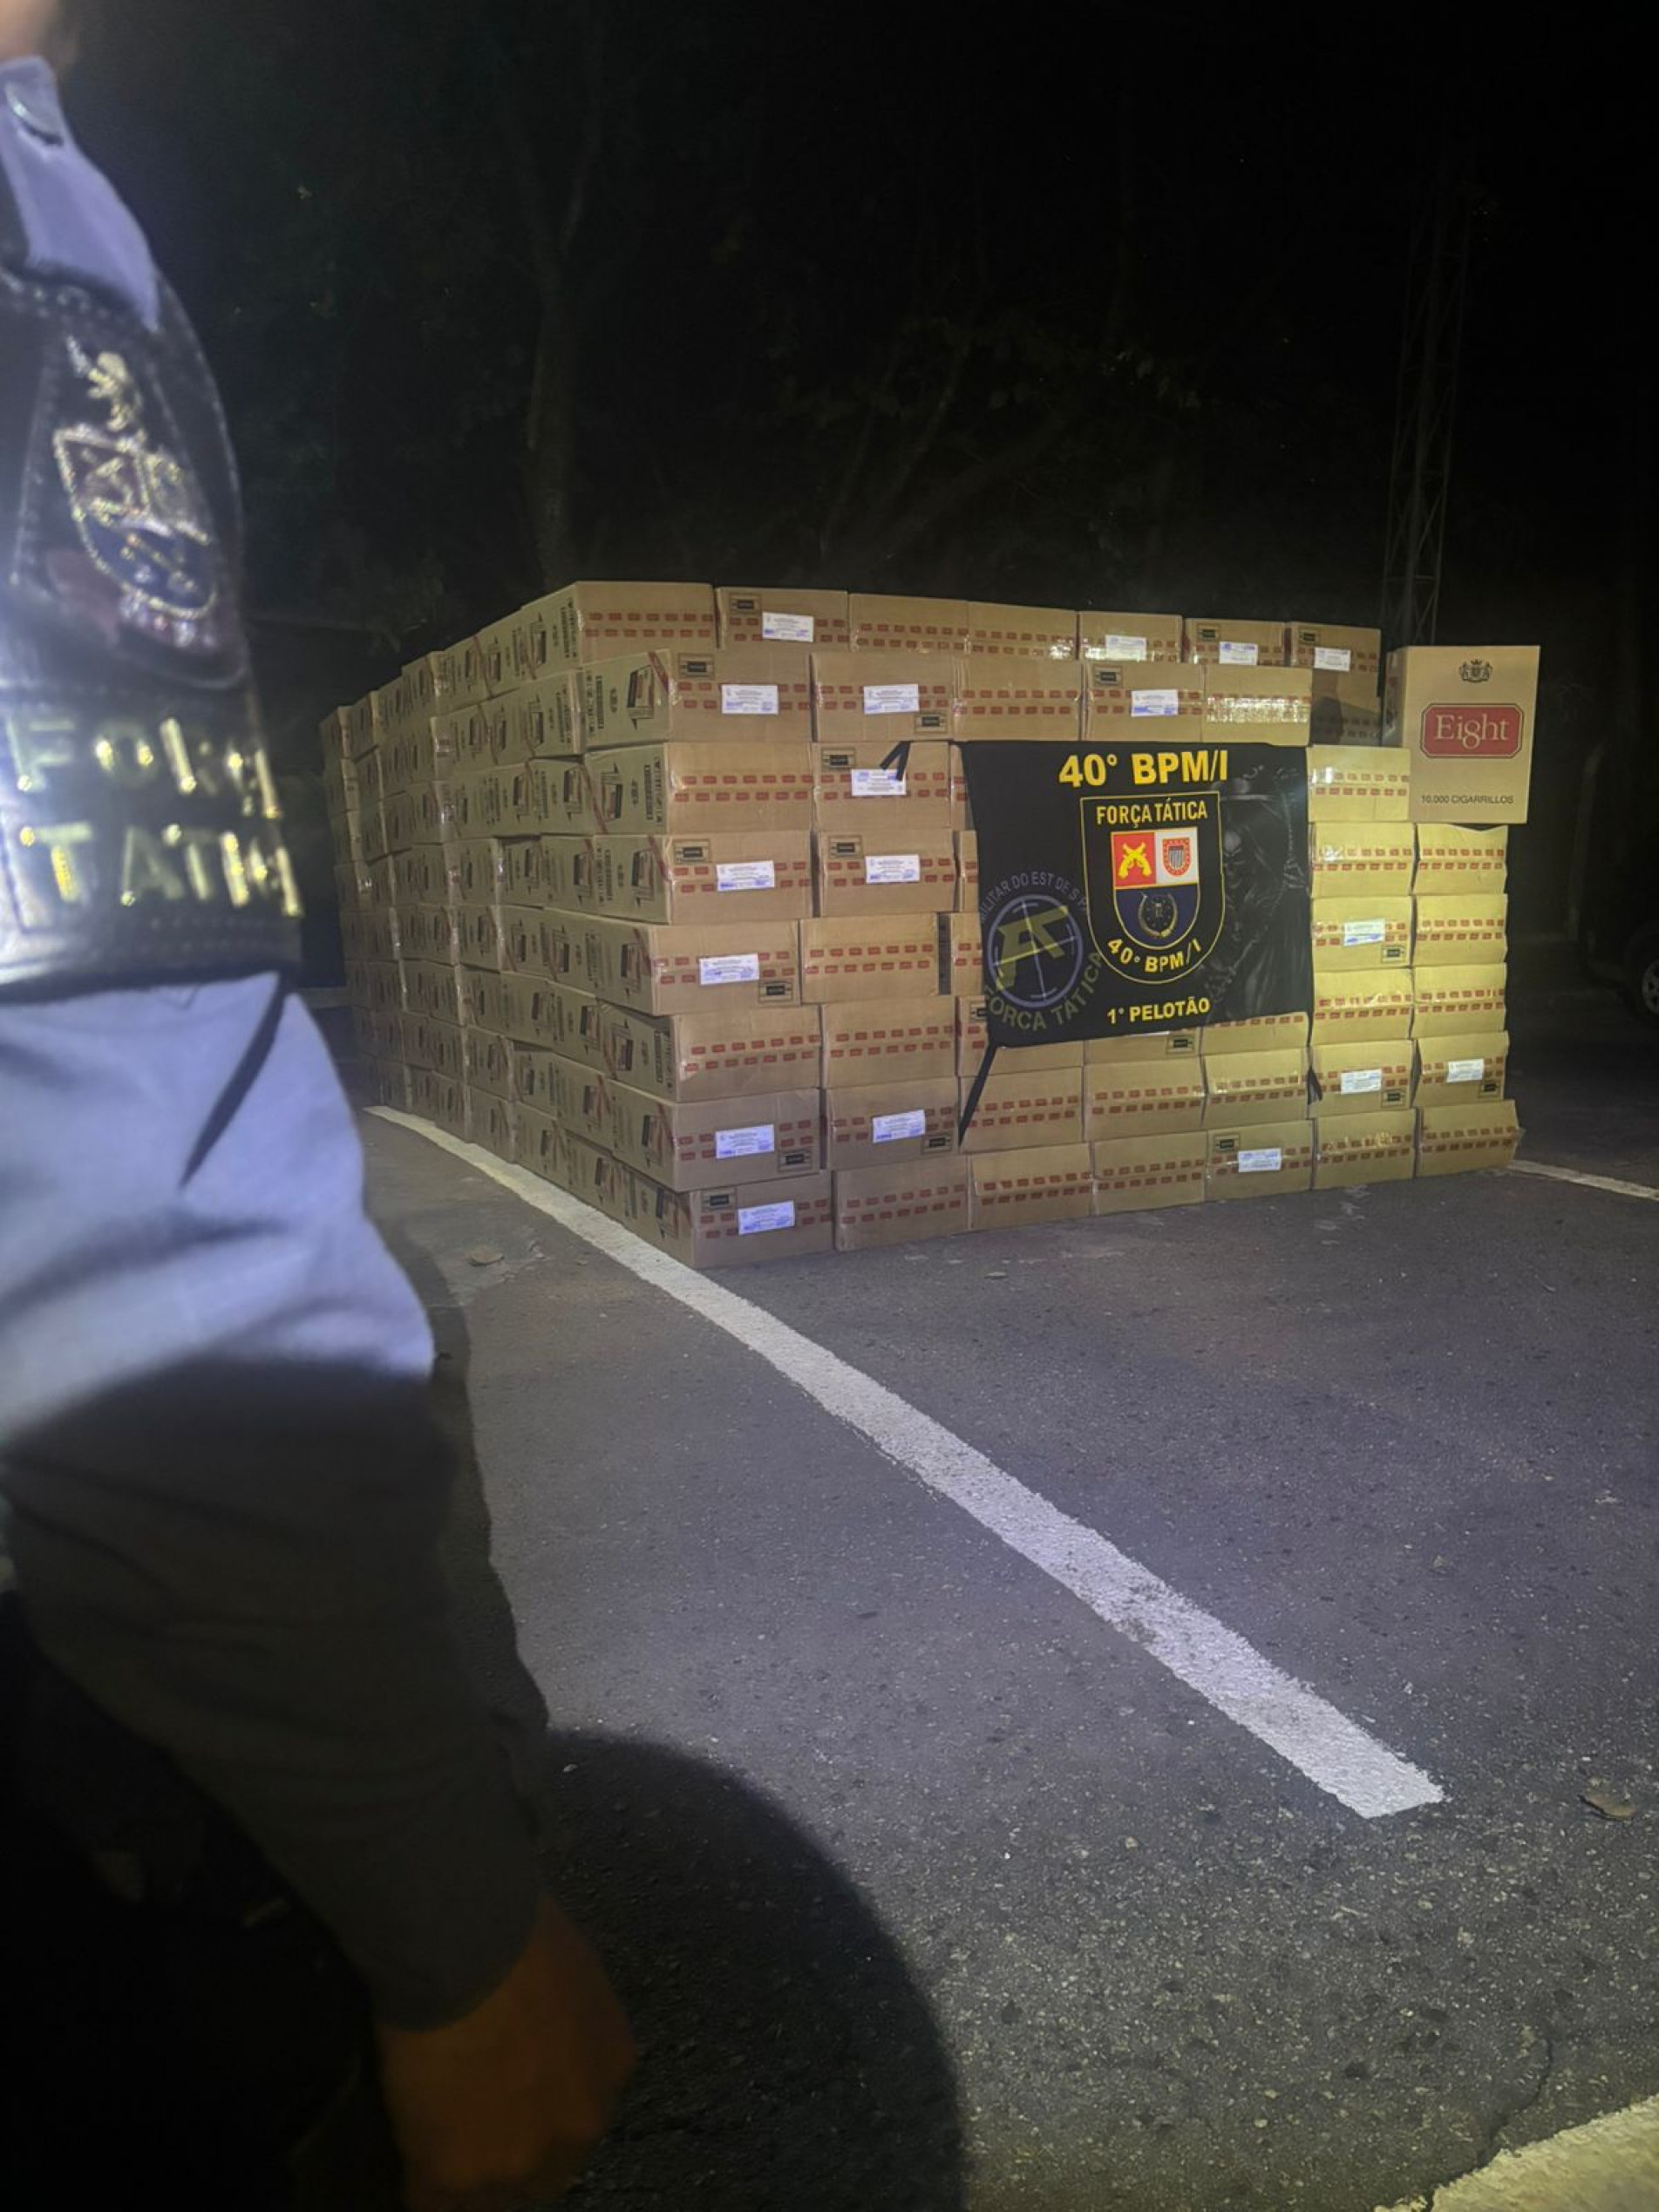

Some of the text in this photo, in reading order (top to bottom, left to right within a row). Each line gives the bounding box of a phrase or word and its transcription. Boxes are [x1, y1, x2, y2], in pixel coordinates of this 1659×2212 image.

[1435, 713, 1510, 750] Eight
[1131, 750, 1228, 784] BPM/I
[1096, 797, 1208, 828] FORÇA TÁTICA
[1421, 794, 1514, 804] 10.000 CIGARRILLOS
[1144, 938, 1202, 973] BPM/I
[1128, 995, 1211, 1023] PELOTÃO
